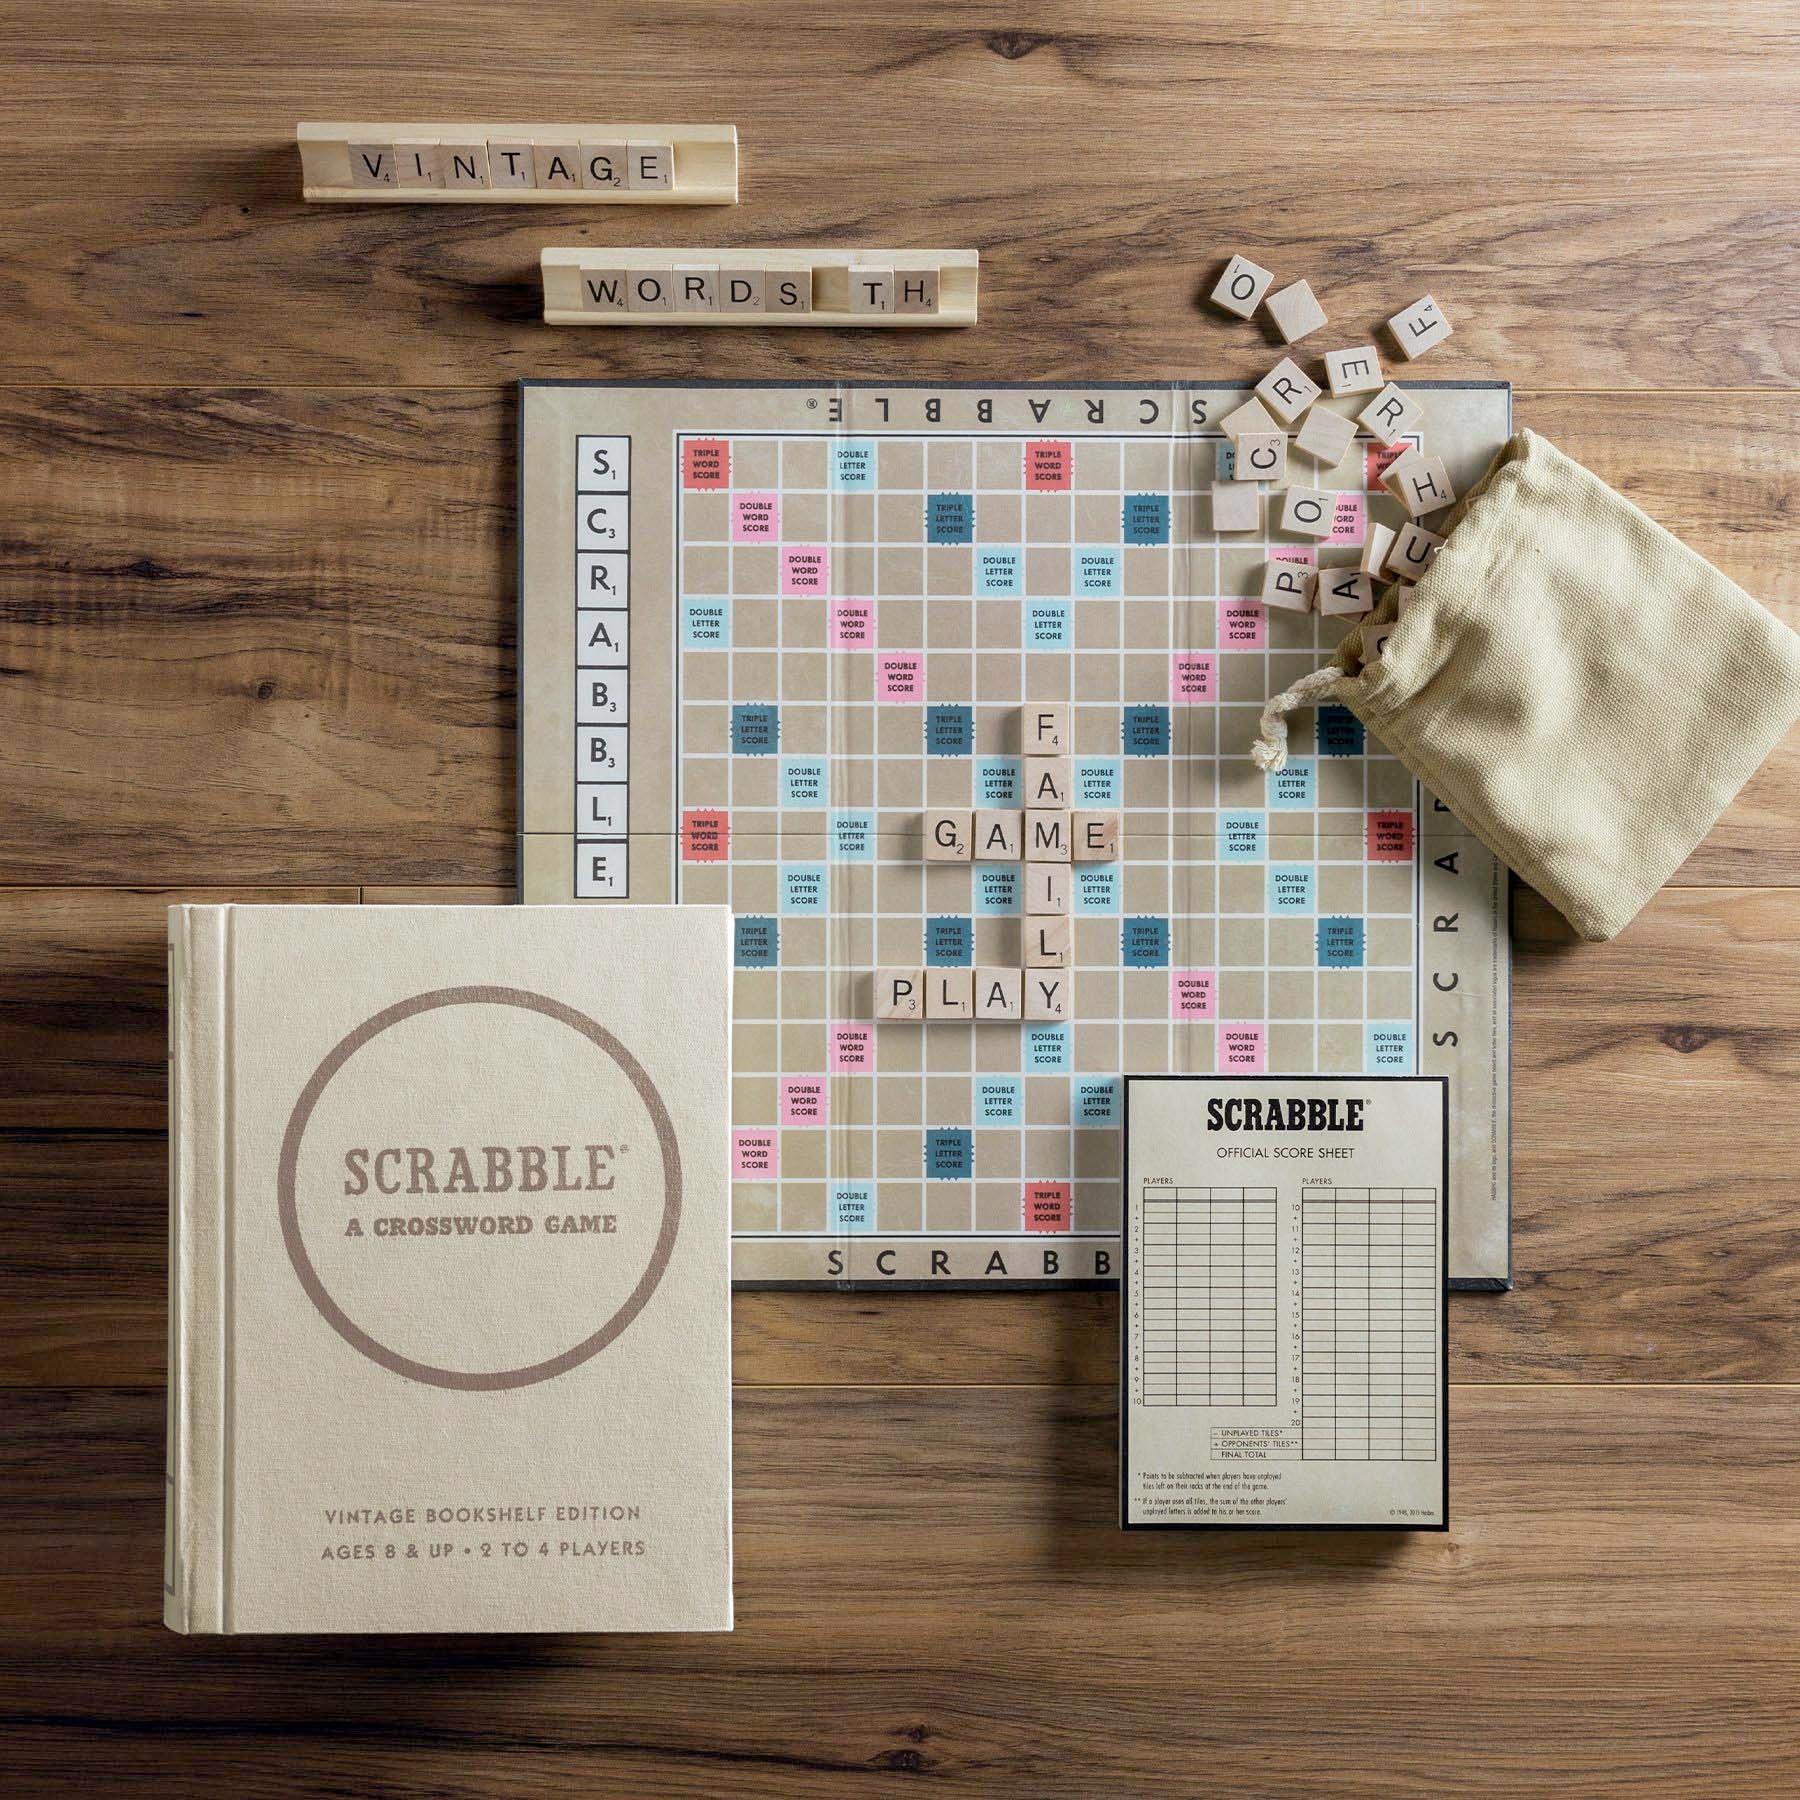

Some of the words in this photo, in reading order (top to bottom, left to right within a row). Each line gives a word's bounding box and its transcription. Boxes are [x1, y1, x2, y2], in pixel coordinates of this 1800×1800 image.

[694, 450, 719, 458] TRIPLE
[838, 451, 868, 459] DOUBLE
[1035, 451, 1061, 459] TRIPLE
[693, 461, 719, 469] WORD
[840, 462, 865, 470] LETTER
[1035, 462, 1061, 470] WORD
[693, 472, 719, 480] SCORE
[841, 473, 865, 481] SCORE
[1035, 473, 1061, 481] SCORE
[740, 503, 772, 511] DOUBLE
[1134, 505, 1159, 513] TRIPLE
[743, 514, 768, 522] WORD
[1133, 516, 1159, 524] LETTER
[743, 525, 768, 533] SCORE
[1134, 527, 1160, 535] SCORE
[789, 556, 821, 564] DOUBLE
[984, 557, 1015, 565] DOUBLE
[792, 567, 817, 575] WORD
[986, 568, 1012, 576] LETTER
[792, 578, 817, 586] SCORE
[987, 579, 1013, 587] SCORE
[690, 609, 722, 617] DOUBLE
[693, 620, 719, 628] LETTER
[1230, 620, 1255, 629] WORD
[693, 631, 719, 639] SCORE
[1230, 631, 1255, 640] SCORE
[885, 662, 916, 670] DOUBLE
[888, 673, 913, 681] WORD
[888, 685, 913, 693] SCORE
[936, 716, 961, 724] TRIPLE
[936, 727, 962, 735] LETTER
[936, 738, 962, 746] SCORE
[789, 768, 820, 776] DOUBLE
[1082, 769, 1113, 777] DOUBLE
[791, 779, 817, 787] LETTER
[1084, 780, 1110, 788] LETTER
[792, 790, 817, 798] SCORE
[1085, 791, 1110, 799] SCORE
[1227, 822, 1258, 830] DOUBLE
[1229, 833, 1255, 841] LETTER
[1229, 844, 1255, 852] SCORE
[788, 875, 820, 883] DOUBLE
[1276, 875, 1308, 883] DOUBLE
[791, 886, 817, 894] LETTER
[1278, 886, 1305, 894] LETTER
[791, 897, 817, 905] SCORE
[1279, 897, 1305, 905] SCORE
[1328, 928, 1353, 936] TRIPLE
[1327, 939, 1353, 947] LETTER
[1328, 950, 1353, 958] SCORE
[1179, 980, 1208, 988] DOUBLE
[1182, 991, 1205, 999] WORD
[1181, 1002, 1206, 1010] SCORE
[837, 1033, 867, 1041] DOUBLE
[1374, 1034, 1406, 1042] DOUBLE
[840, 1044, 864, 1052] WORD
[1376, 1045, 1403, 1053] LETTER
[840, 1055, 864, 1063] SCORE
[1377, 1056, 1402, 1064] SCORE
[983, 1086, 1014, 1094] DOUBLE
[985, 1097, 1012, 1105] LETTER
[985, 1109, 1012, 1117] SCORE
[739, 1139, 770, 1147] DOUBLE
[742, 1150, 767, 1158] WORD
[1216, 1147, 1269, 1159] OFFICIAL
[1273, 1147, 1314, 1159] SCORE
[1318, 1147, 1355, 1159] SHEET
[742, 1161, 768, 1169] SCORE
[1143, 1177, 1174, 1185] PLAYERS
[1302, 1177, 1333, 1185] PLAYERS
[1035, 1192, 1060, 1200] TRIPLE
[1034, 1203, 1060, 1211] WORD
[1292, 1204, 1300, 1212] 10
[1034, 1214, 1061, 1222] SCORE
[344, 1218, 364, 1237] A
[374, 1215, 534, 1236] CROSSWORD
[545, 1214, 617, 1234] GAME
[1292, 1226, 1300, 1234] 11
[1292, 1247, 1300, 1255] 12
[1292, 1269, 1300, 1277] 13
[1292, 1290, 1300, 1298] 14
[1292, 1312, 1300, 1320] 15
[1292, 1333, 1300, 1341] 16
[1292, 1355, 1300, 1363] 17
[1292, 1376, 1300, 1384] 18
[1292, 1398, 1300, 1406] 19
[1291, 1419, 1300, 1427] 20
[1221, 1429, 1259, 1437] UNPLAYED
[1221, 1451, 1242, 1459] FINAL
[1245, 1451, 1267, 1459] TOTAL
[325, 1508, 415, 1525] VINTAGE
[426, 1507, 546, 1523] BOOKSHELF
[556, 1506, 640, 1521] EDITION
[321, 1544, 375, 1560] AGES
[385, 1543, 396, 1559] 8
[406, 1543, 419, 1559] &
[429, 1543, 454, 1558] UP
[480, 1543, 491, 1557] 2
[502, 1542, 528, 1557] TO
[539, 1542, 549, 1556] 4
[560, 1541, 646, 1557] PLAYERS
